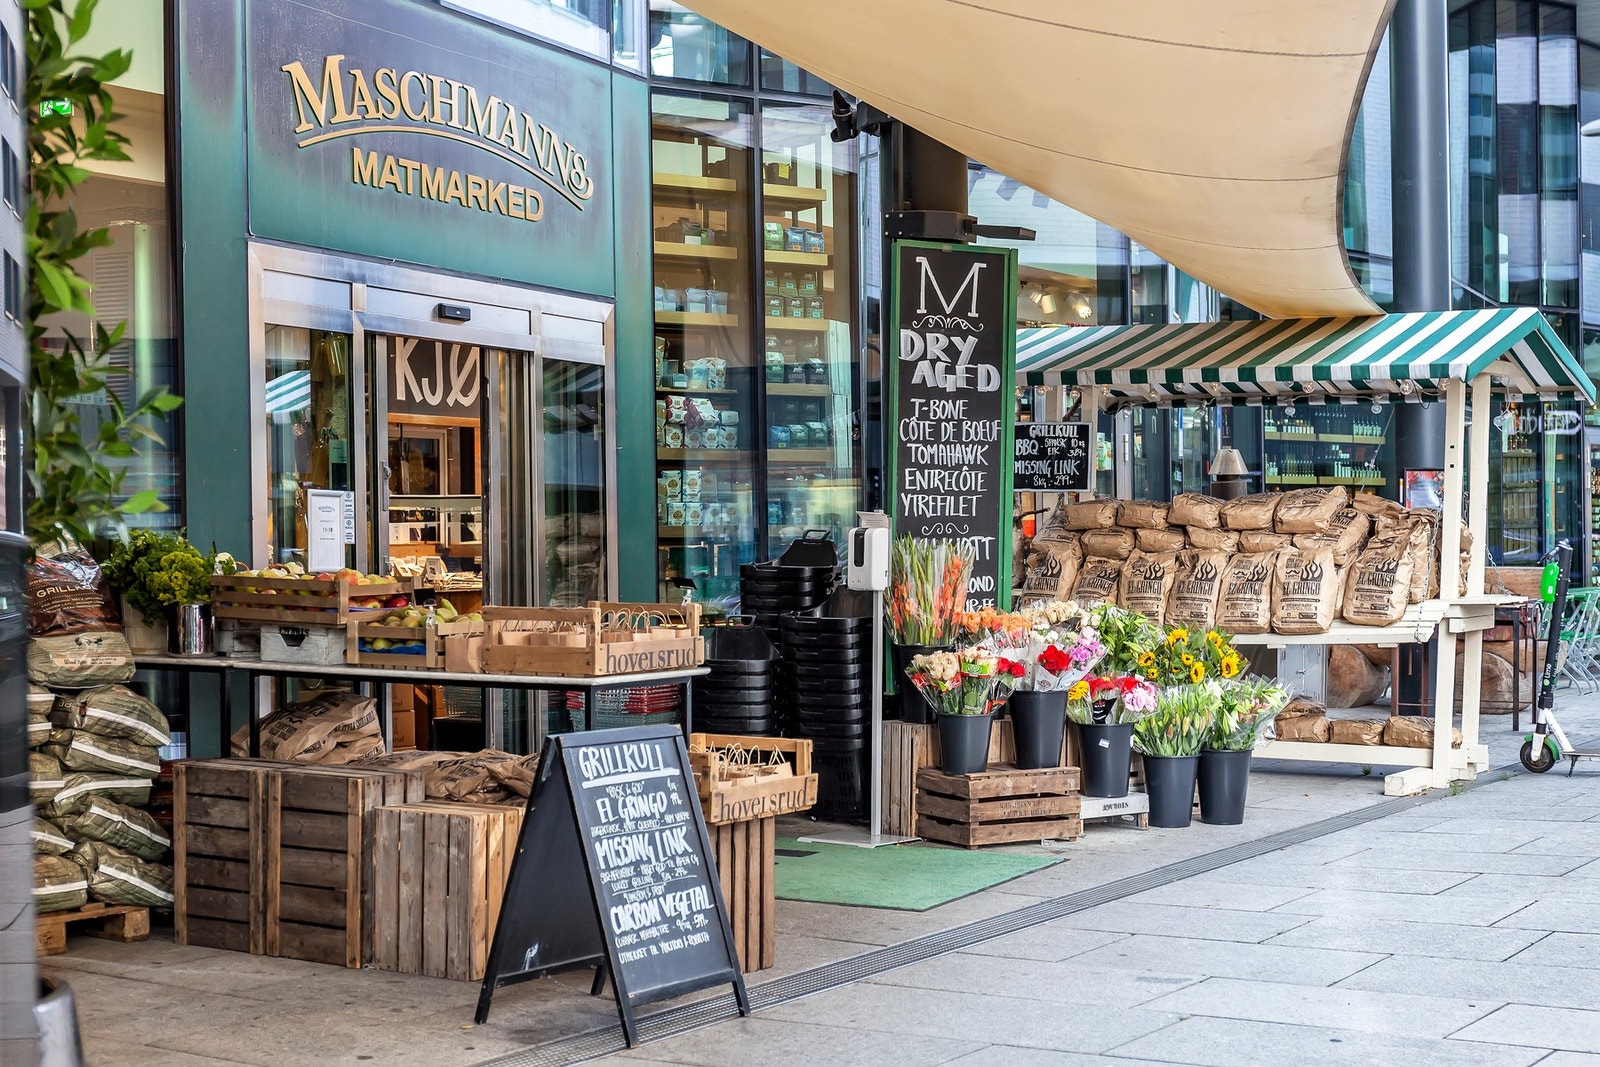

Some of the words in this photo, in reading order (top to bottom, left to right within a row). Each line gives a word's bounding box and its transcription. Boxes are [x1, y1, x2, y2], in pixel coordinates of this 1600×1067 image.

[352, 146, 544, 222] MATMARKED
[915, 256, 987, 317] M
[898, 328, 978, 366] DRY
[911, 360, 1001, 393] AGED
[910, 398, 968, 420] T-BONE
[899, 416, 936, 441] CÔTE
[941, 421, 958, 442] DE
[1029, 425, 1079, 438] GRILLKULL
[906, 442, 989, 467] TOMAHAWK
[1015, 439, 1039, 456] BBQ
[904, 465, 988, 493] ENTRECÔTE
[1014, 460, 1052, 478] MISSING
[1054, 459, 1080, 476] LINK
[900, 492, 982, 518] YTREFILET
[578, 743, 664, 780] GRILLKULL
[596, 797, 619, 823] EL
[617, 791, 668, 825] GRINGO
[594, 832, 656, 870] MISSING
[655, 826, 693, 862] LINK
[610, 898, 661, 935] CARBON
[659, 884, 715, 921] VEGETAL
